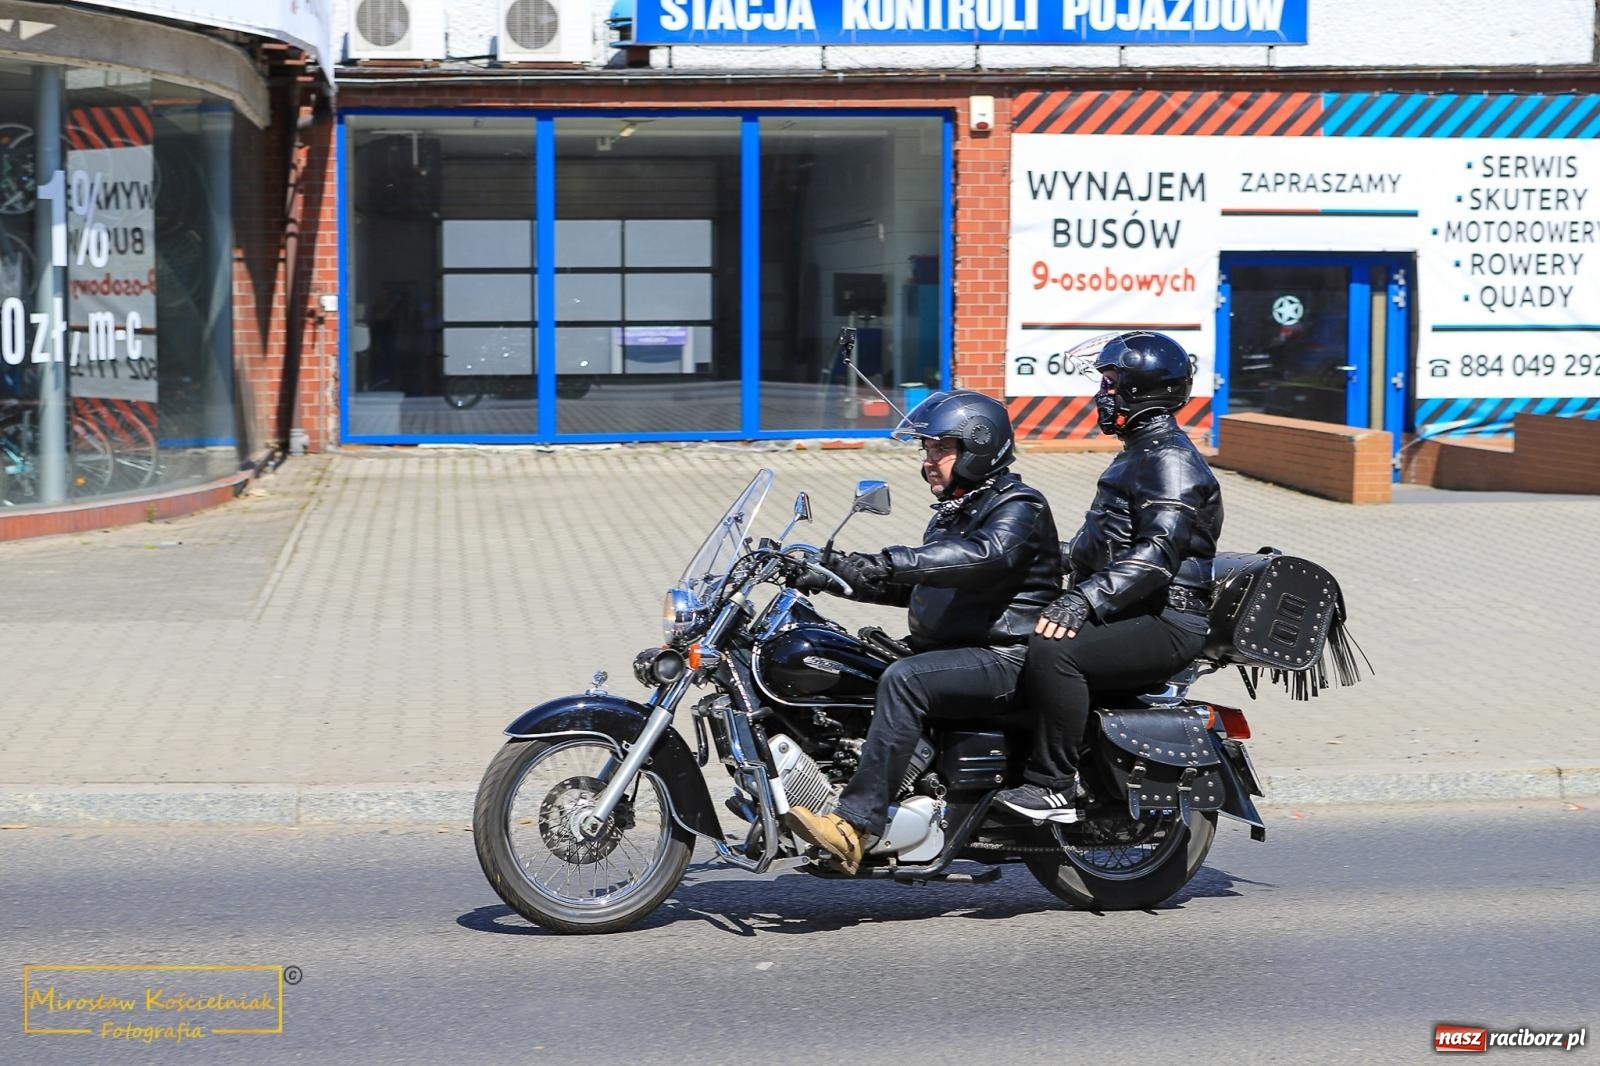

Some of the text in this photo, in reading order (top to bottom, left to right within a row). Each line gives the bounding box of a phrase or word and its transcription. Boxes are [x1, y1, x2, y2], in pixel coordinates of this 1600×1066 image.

[660, 0, 817, 31] STACJA
[842, 0, 1038, 31] KONTROLI
[1482, 155, 1577, 178] SERWIS
[1027, 170, 1206, 202] WYNAJEM
[1240, 172, 1402, 193] ZAPRASZAMY
[1470, 188, 1588, 210] SKUTERY
[37, 170, 110, 268] 1%
[1053, 209, 1181, 249] BUSÓW
[1444, 221, 1600, 243] MOTOROWER
[1470, 253, 1584, 275] ROWERY
[1032, 261, 1196, 297] 9-osobowych
[1480, 285, 1573, 312] QUADY
[1460, 354, 1503, 377] 884
[1513, 354, 1556, 377] 049
